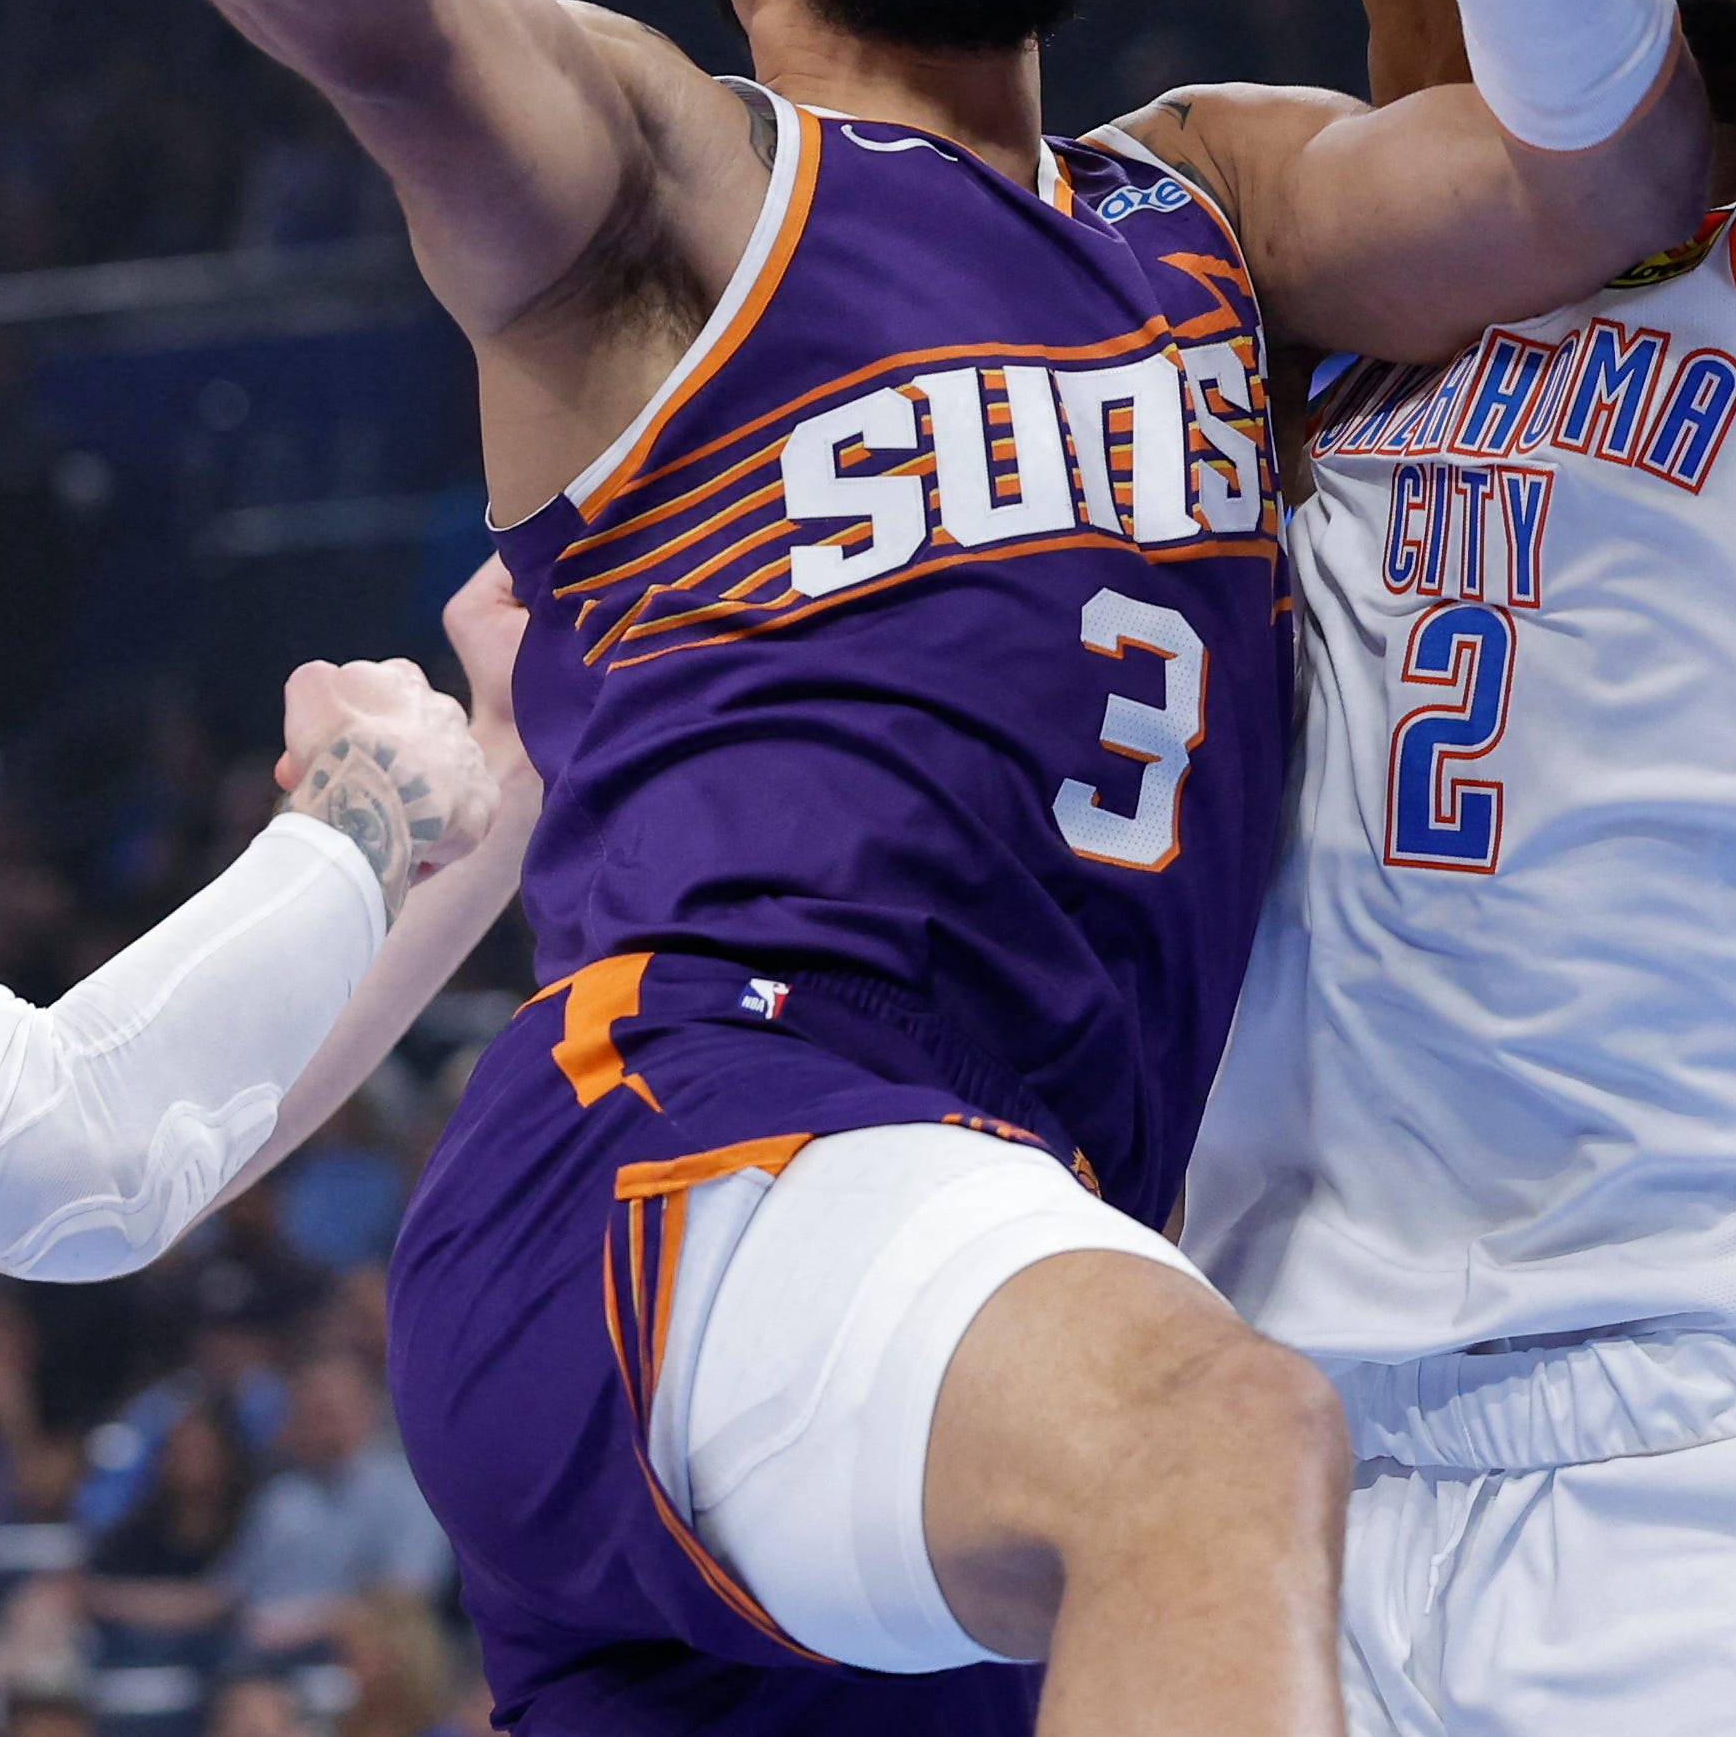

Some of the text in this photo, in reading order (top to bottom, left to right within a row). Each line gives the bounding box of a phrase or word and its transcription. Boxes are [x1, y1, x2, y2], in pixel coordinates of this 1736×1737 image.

[780, 342, 1260, 599] SUNS
[1382, 462, 1554, 609] CITY
[1052, 587, 1209, 872] 3
[1383, 599, 1517, 874] 2
